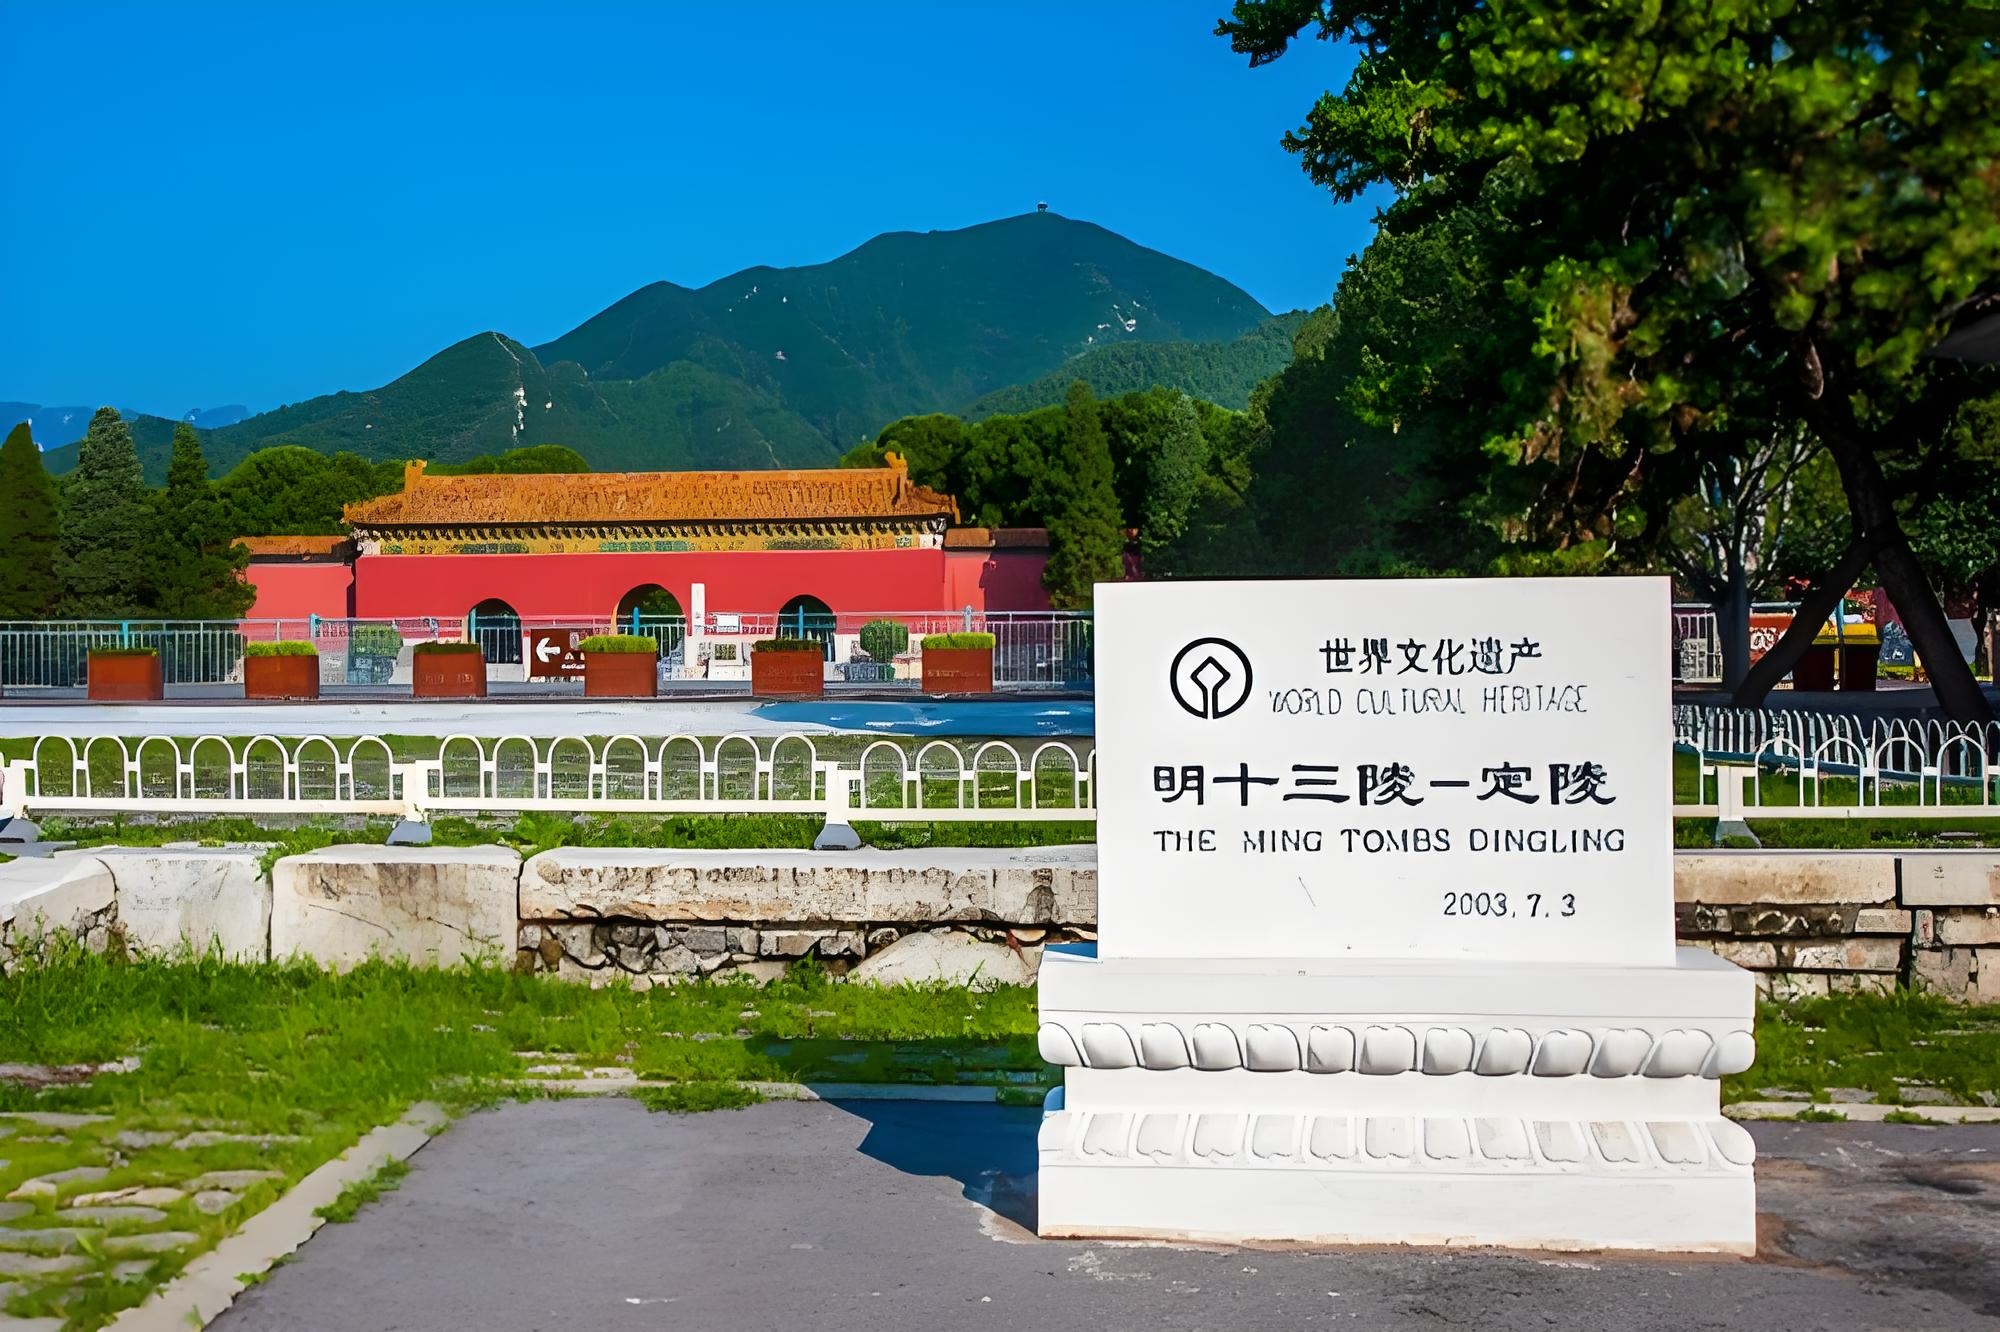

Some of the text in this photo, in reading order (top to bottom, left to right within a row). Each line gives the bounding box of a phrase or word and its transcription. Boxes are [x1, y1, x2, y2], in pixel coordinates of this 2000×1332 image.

[1318, 636, 1543, 676] 世界文化遗产
[1483, 684, 1588, 715] HERITAGE
[1152, 827, 1625, 854] THE MING TOMBS DINGLING
